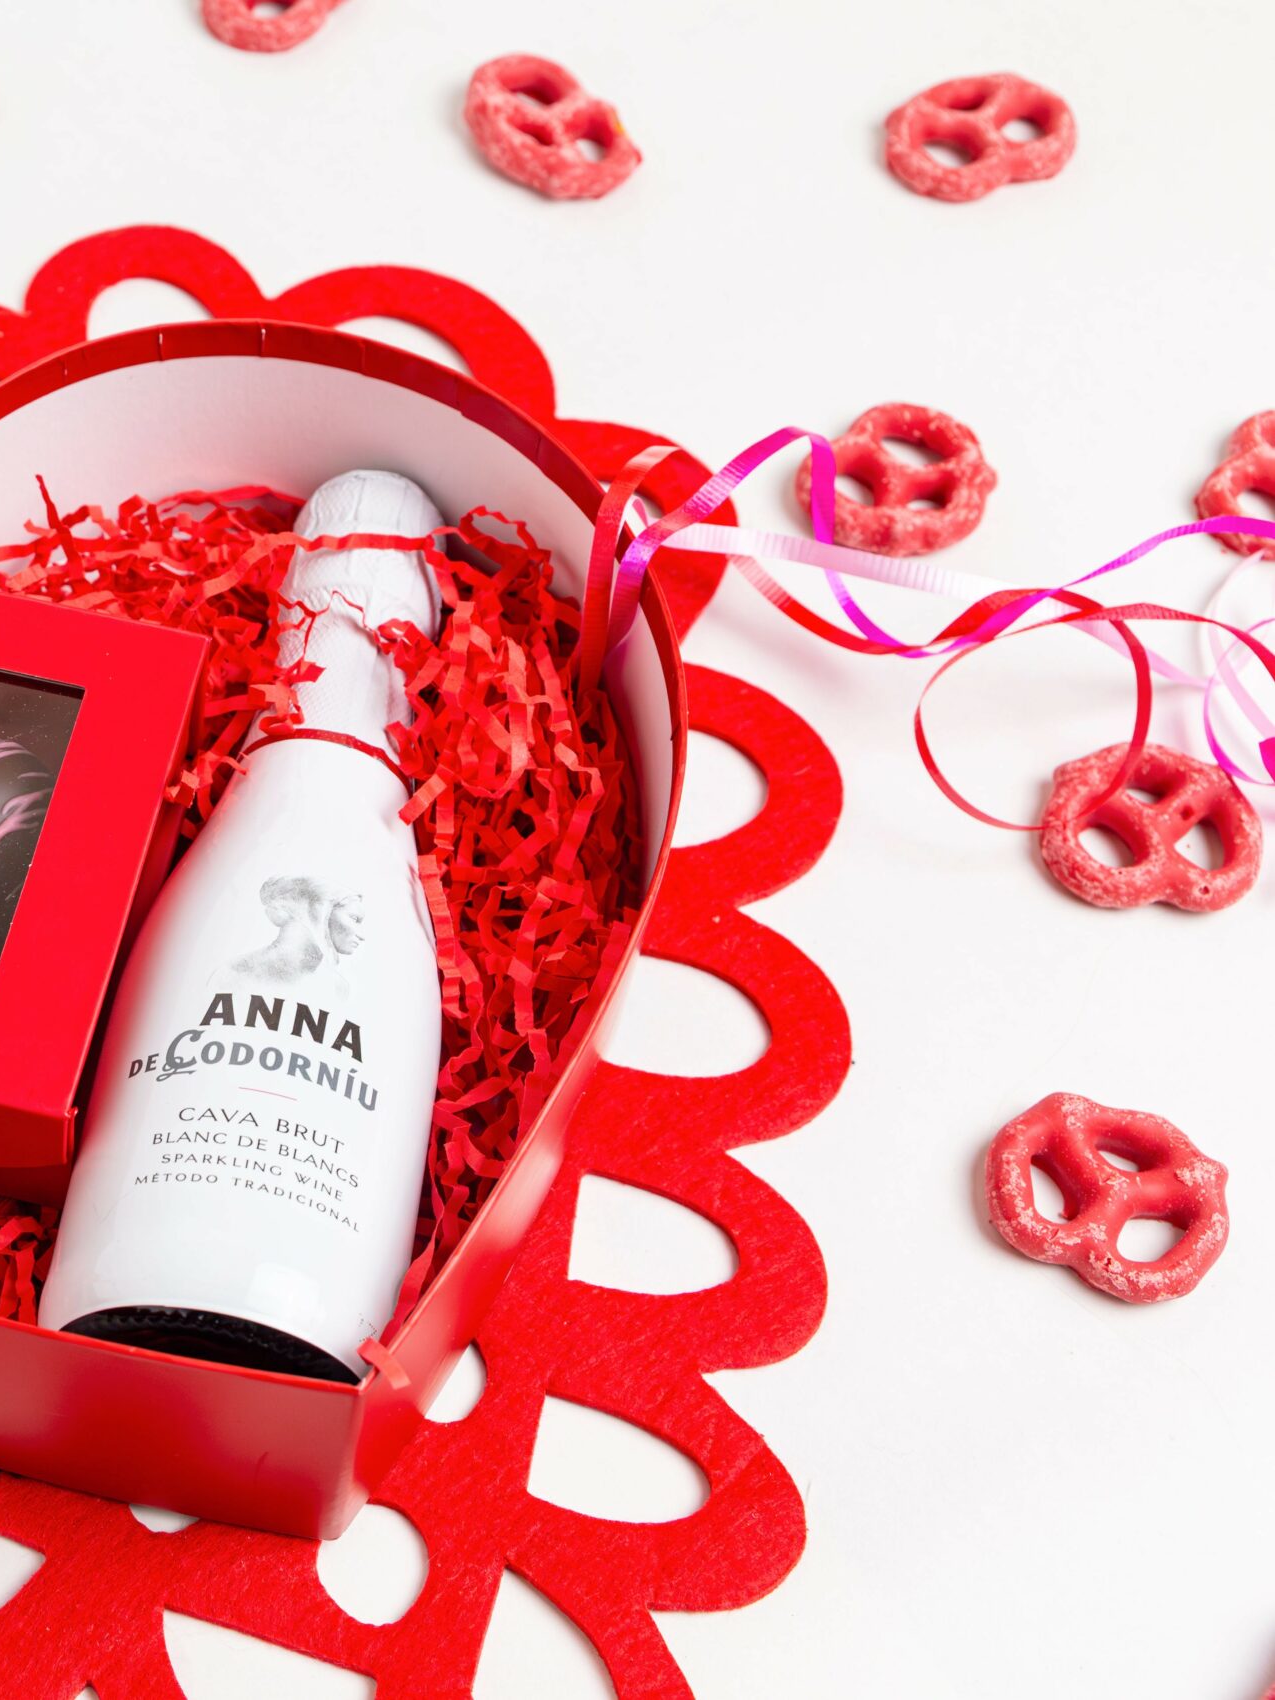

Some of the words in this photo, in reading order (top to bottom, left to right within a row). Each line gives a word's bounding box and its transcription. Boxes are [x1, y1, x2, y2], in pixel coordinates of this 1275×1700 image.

[199, 993, 363, 1063] ANNA
[127, 1053, 160, 1079] DE
[178, 1107, 259, 1127] CAVA
[276, 1118, 345, 1155] BRUT
[152, 1131, 227, 1145] BLANC
[237, 1135, 268, 1152] DE
[277, 1143, 359, 1189] BLANCS
[161, 1153, 282, 1177] SPARKLING
[294, 1171, 343, 1202] WINE
[134, 1172, 218, 1185] MÉTODO
[232, 1177, 360, 1233] TRADICIONAL
